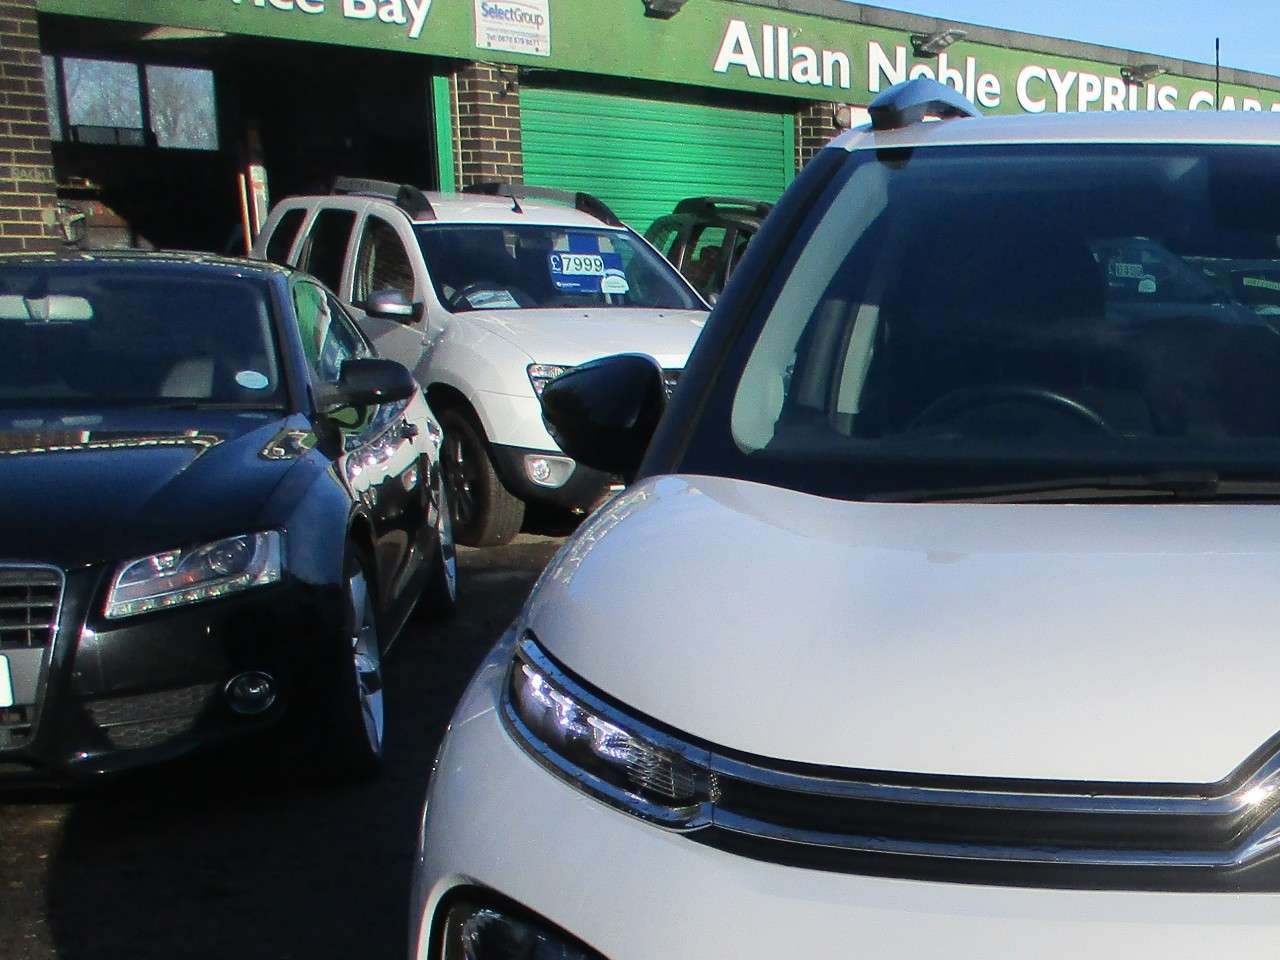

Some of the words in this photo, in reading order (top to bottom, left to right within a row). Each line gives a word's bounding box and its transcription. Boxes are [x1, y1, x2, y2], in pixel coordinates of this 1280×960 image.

[713, 19, 850, 89] Allan
[867, 40, 1001, 108] Noble
[1016, 65, 1180, 113] CYPRUS
